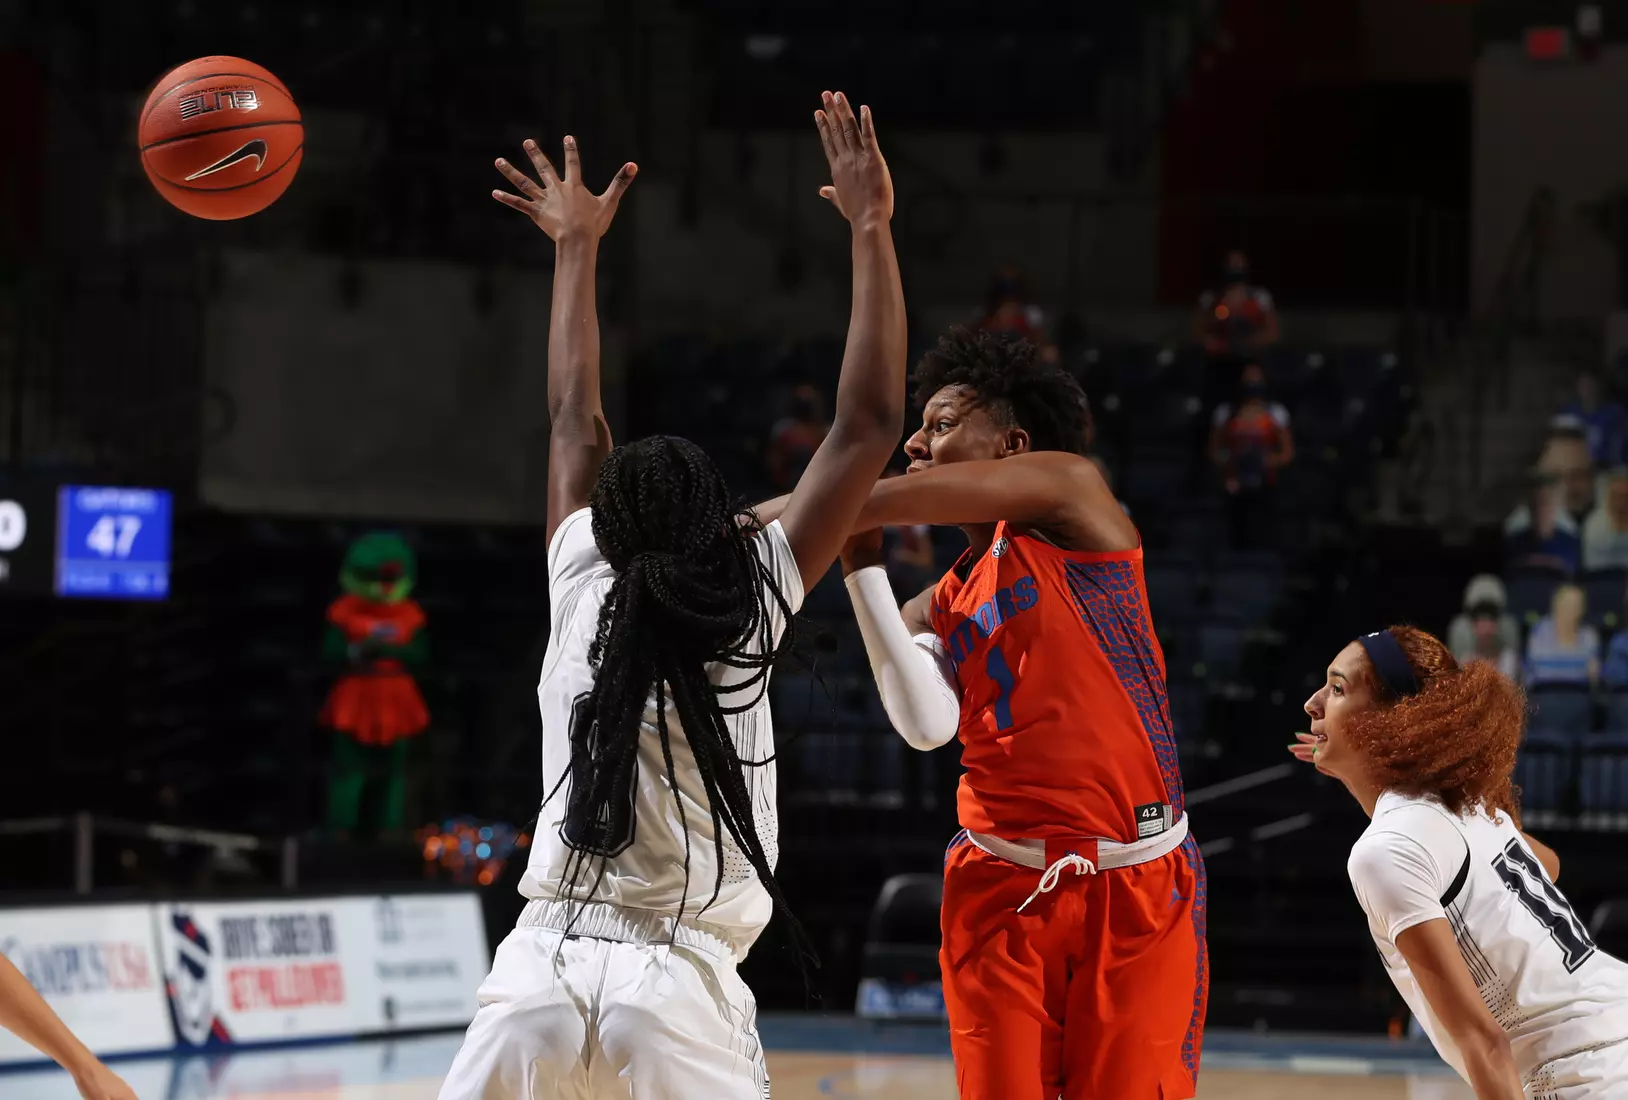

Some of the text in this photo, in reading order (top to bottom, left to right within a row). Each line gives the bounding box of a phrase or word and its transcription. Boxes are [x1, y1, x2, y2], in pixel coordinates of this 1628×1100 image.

[180, 90, 258, 120] ELITE
[86, 514, 143, 560] 47
[985, 644, 1015, 732] 1
[1142, 807, 1158, 818] 42
[1490, 836, 1596, 976] 11
